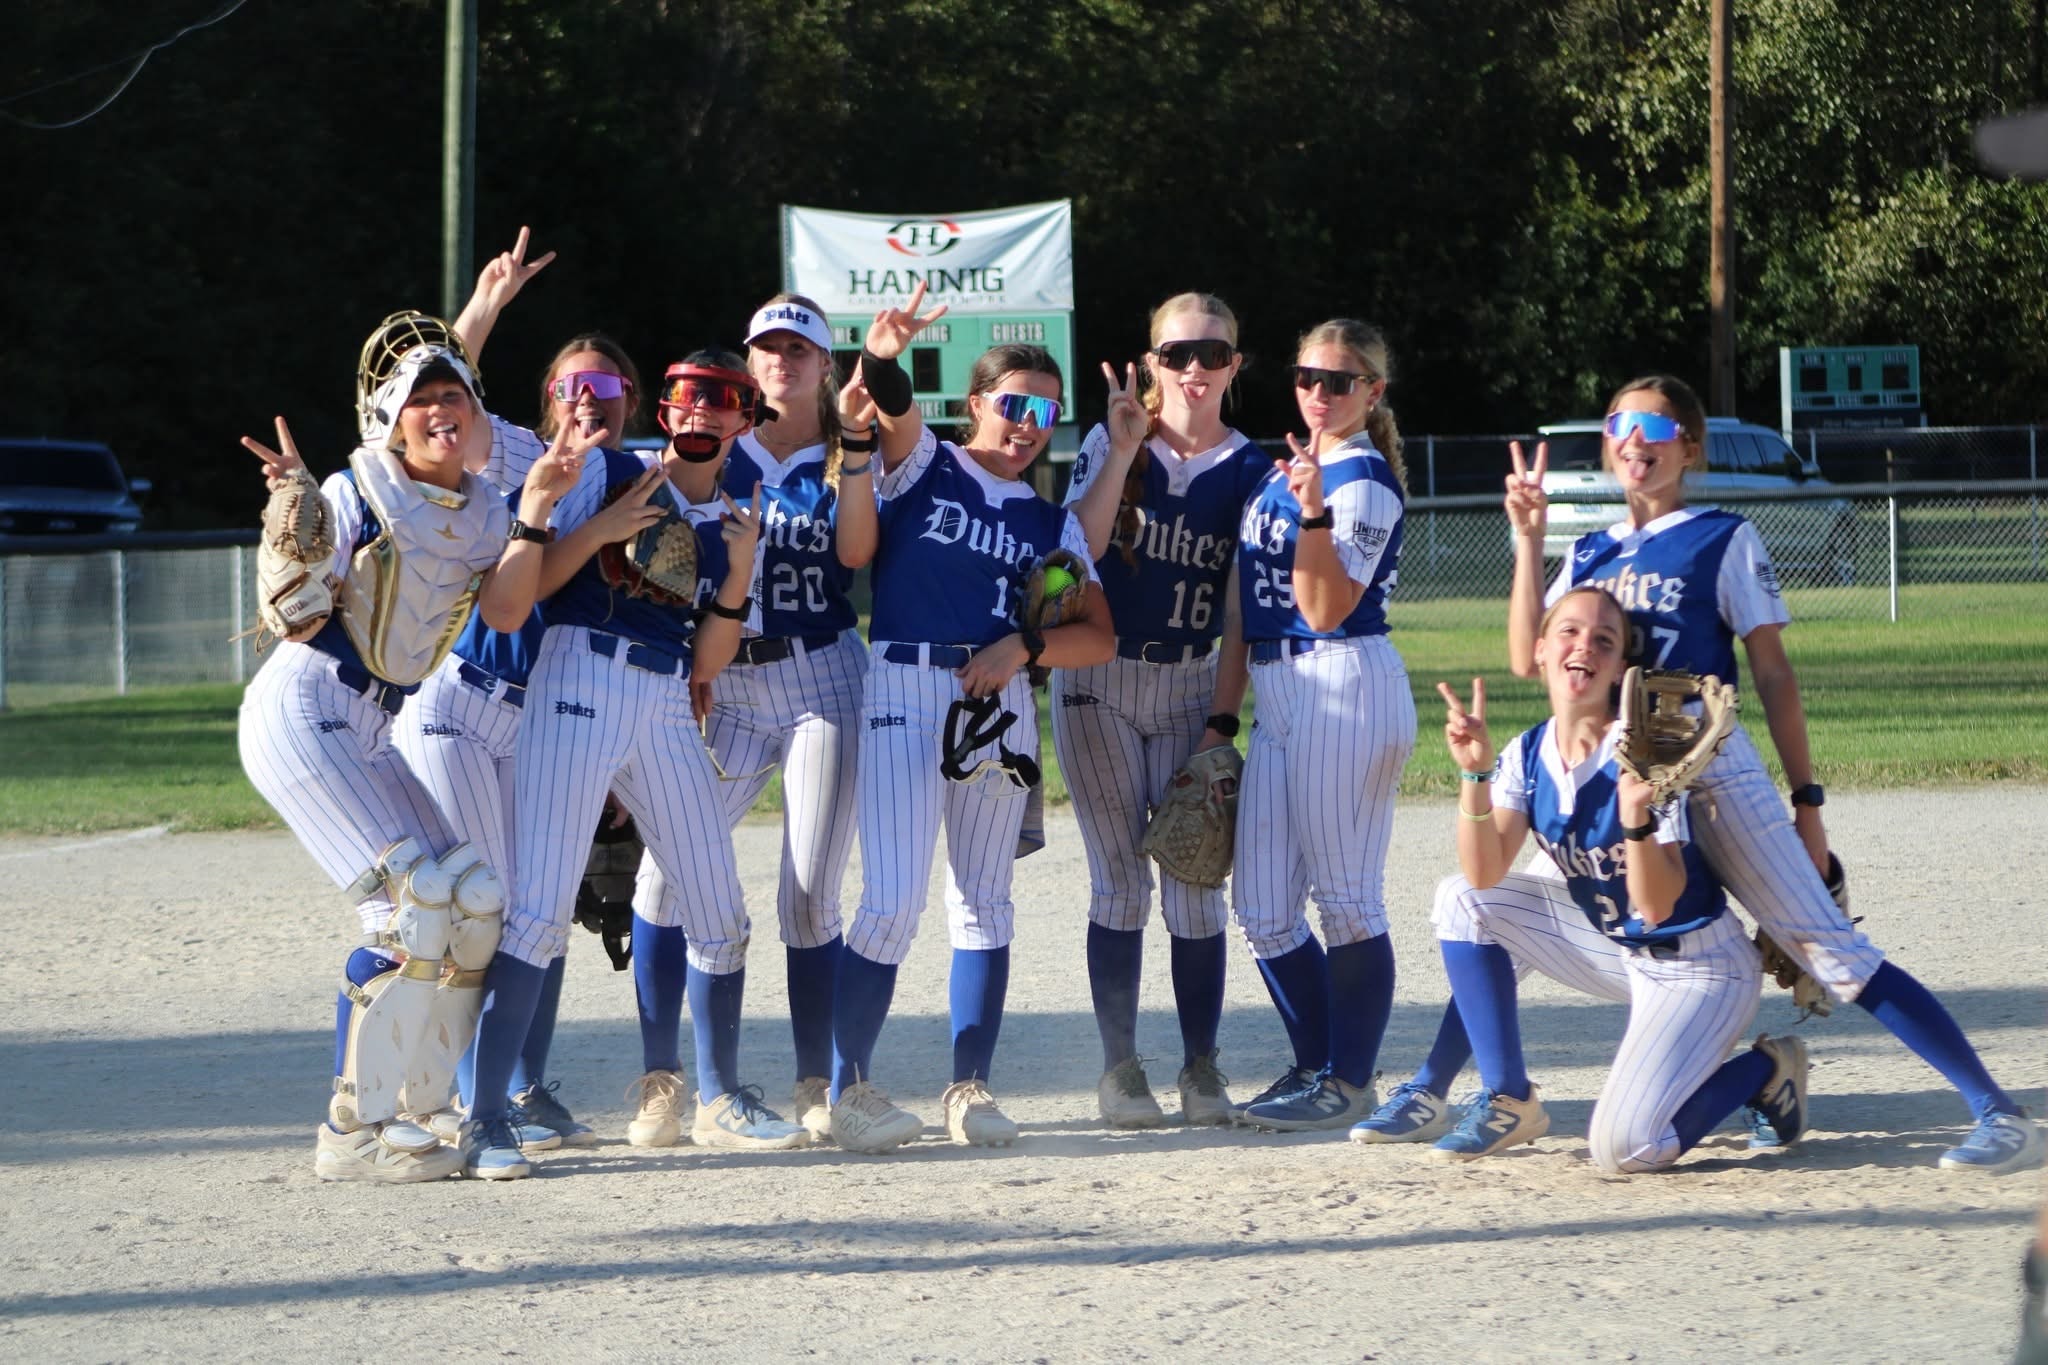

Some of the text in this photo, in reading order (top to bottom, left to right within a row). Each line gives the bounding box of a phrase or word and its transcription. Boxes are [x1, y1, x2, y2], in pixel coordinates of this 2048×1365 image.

[907, 226, 938, 247] H
[848, 266, 1005, 295] HANNIG
[991, 322, 1044, 342] GUESTS
[760, 498, 830, 553] kes
[773, 562, 829, 613] 20
[1254, 560, 1297, 609] 25
[1167, 579, 1214, 630] 16
[554, 700, 596, 719] Dukes
